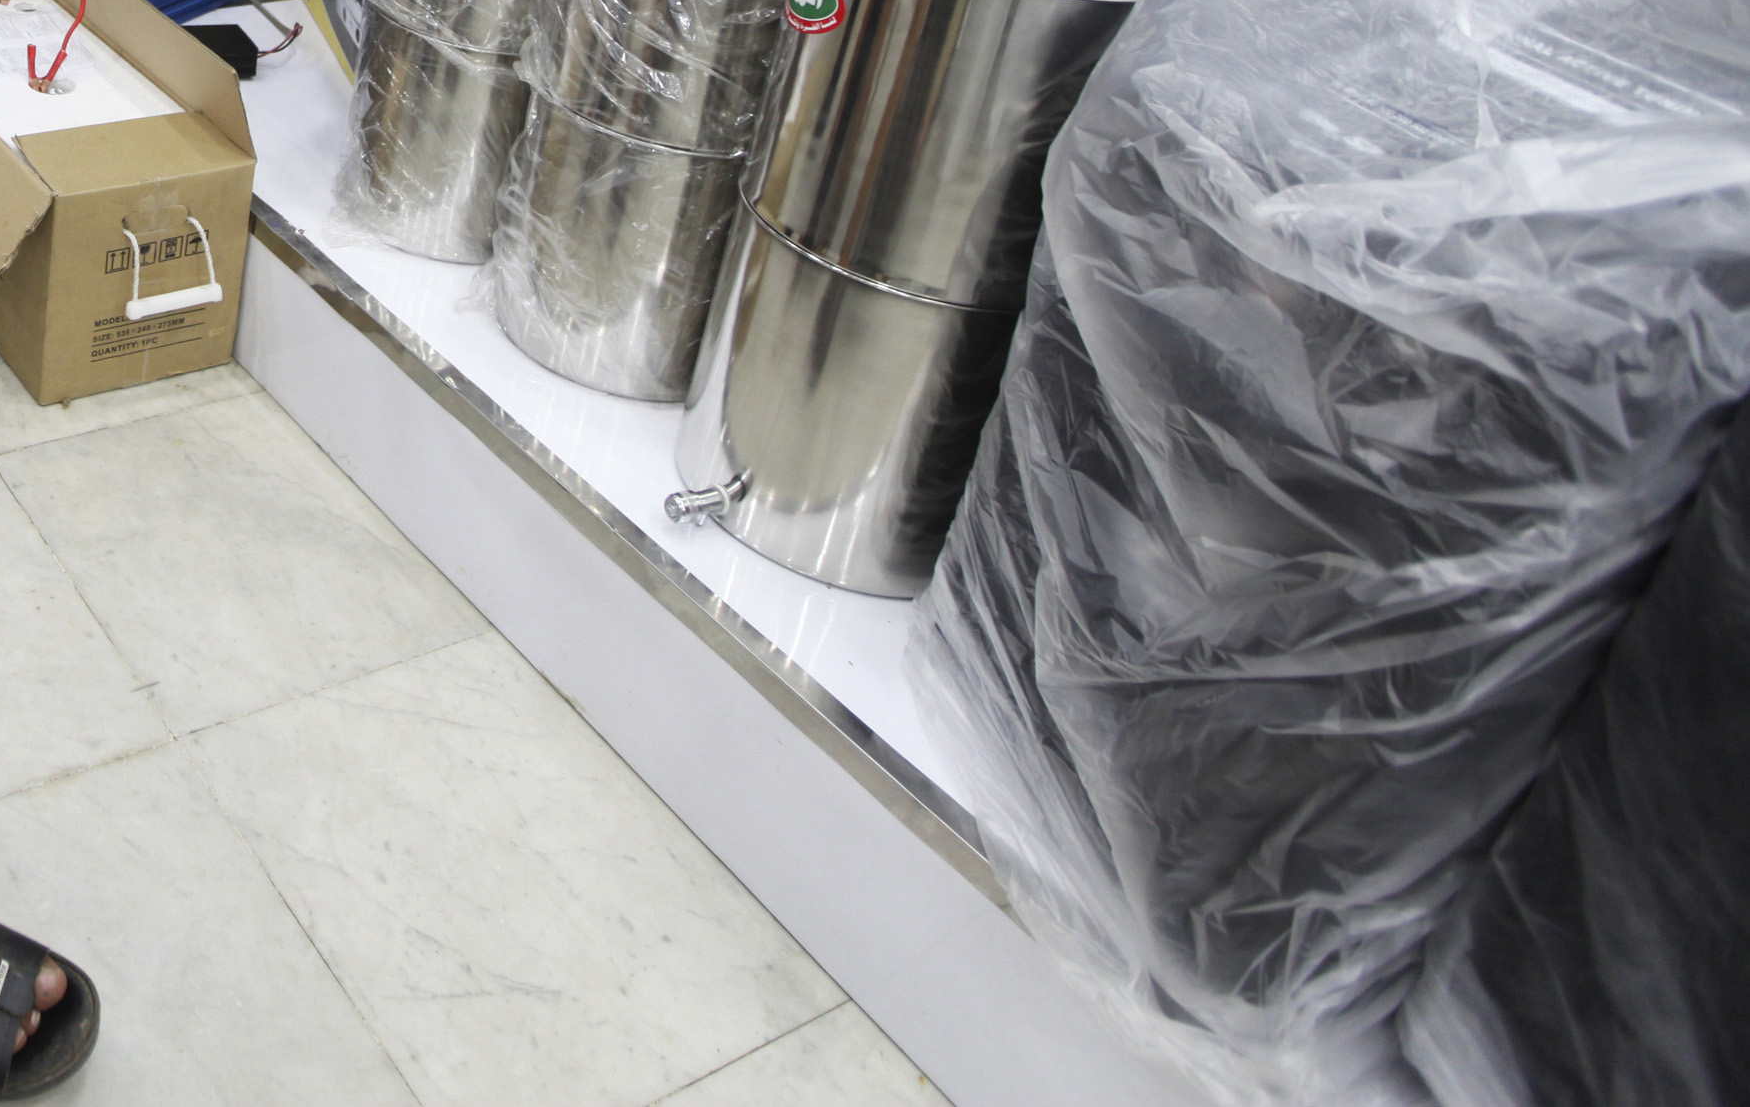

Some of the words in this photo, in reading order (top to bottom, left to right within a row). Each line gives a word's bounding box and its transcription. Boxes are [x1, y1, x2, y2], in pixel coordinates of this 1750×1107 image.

[92, 333, 115, 343] SIZE:
[91, 341, 140, 357] QUANTITY:
[141, 336, 159, 346] 1PC
